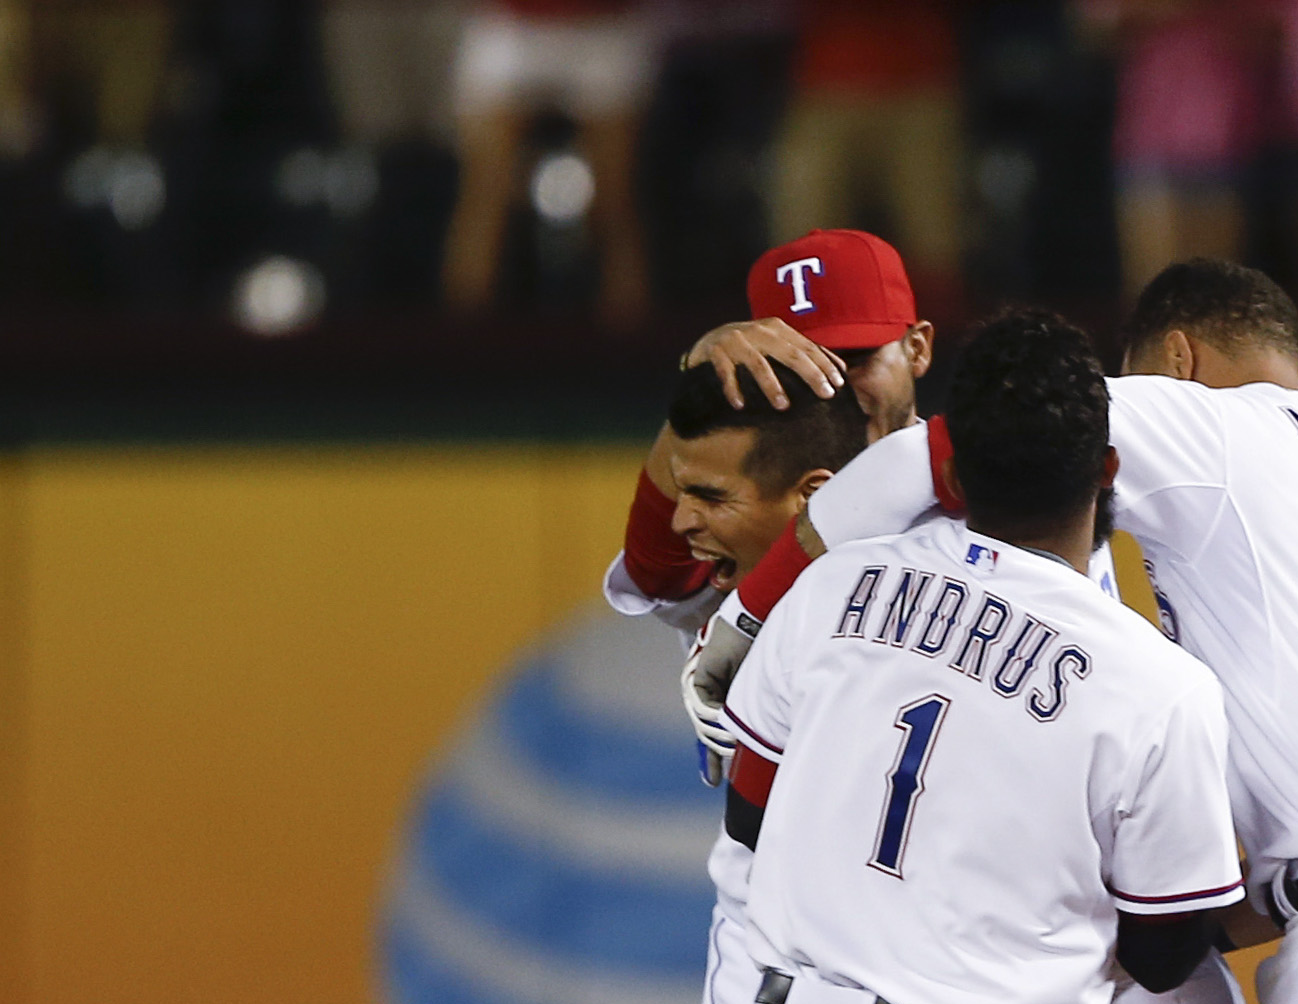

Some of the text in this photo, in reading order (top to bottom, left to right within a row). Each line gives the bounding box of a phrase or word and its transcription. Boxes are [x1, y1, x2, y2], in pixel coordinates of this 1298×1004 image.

[776, 256, 825, 316] T
[831, 564, 1092, 723] ANDRUS
[867, 693, 951, 880] 1
